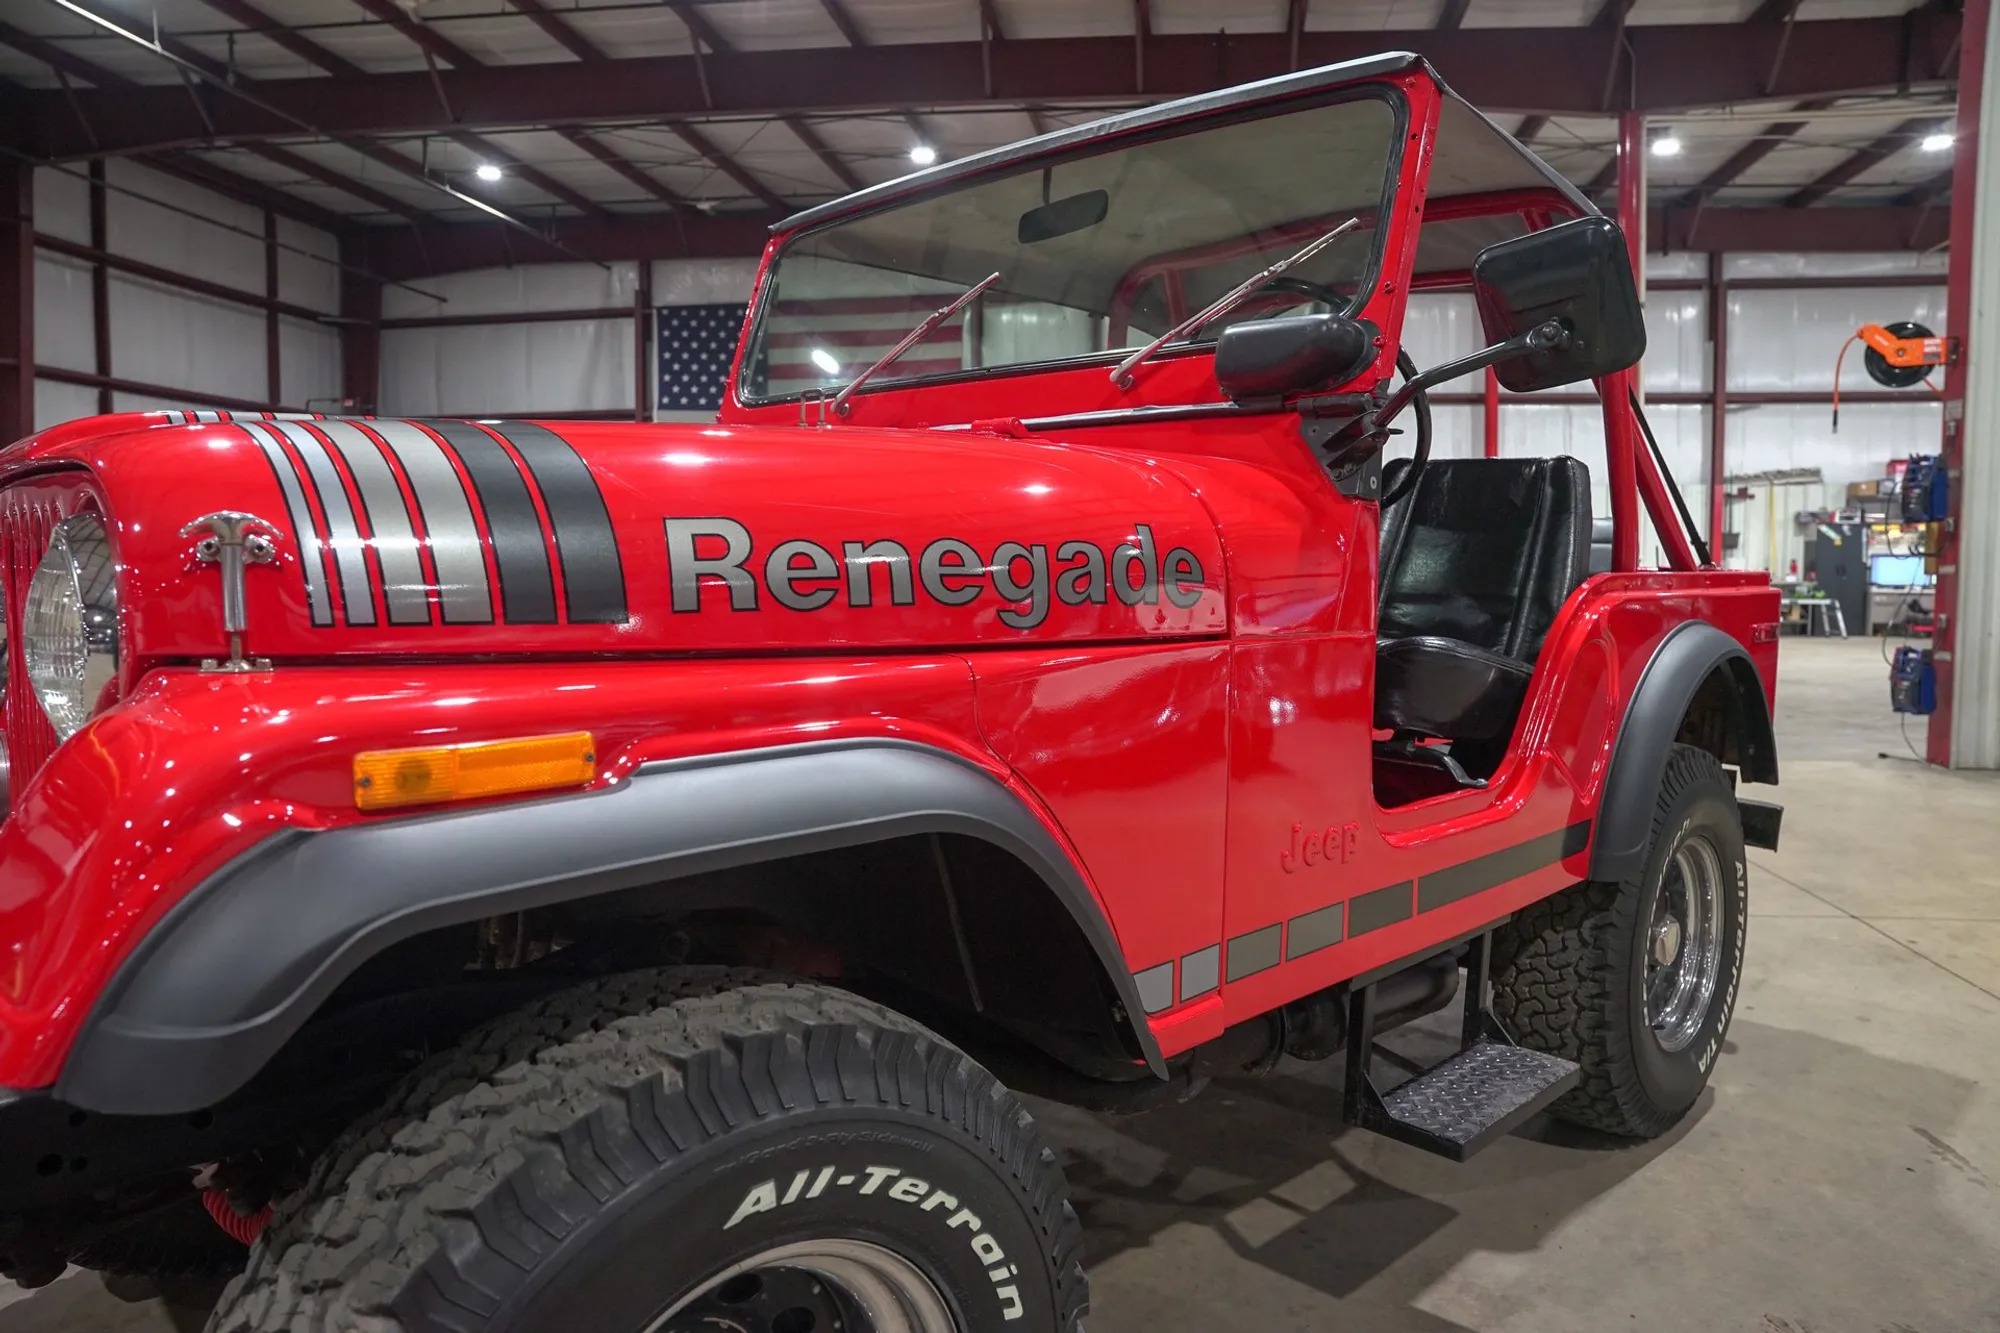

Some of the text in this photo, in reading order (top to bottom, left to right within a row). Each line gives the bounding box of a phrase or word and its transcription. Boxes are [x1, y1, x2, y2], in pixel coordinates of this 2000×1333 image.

[663, 517, 1203, 629] Renegade
[1280, 821, 1359, 874] Jeep
[1698, 861, 1745, 1074] All-Terrain T/A
[723, 1165, 1024, 1321] All-Terrain
